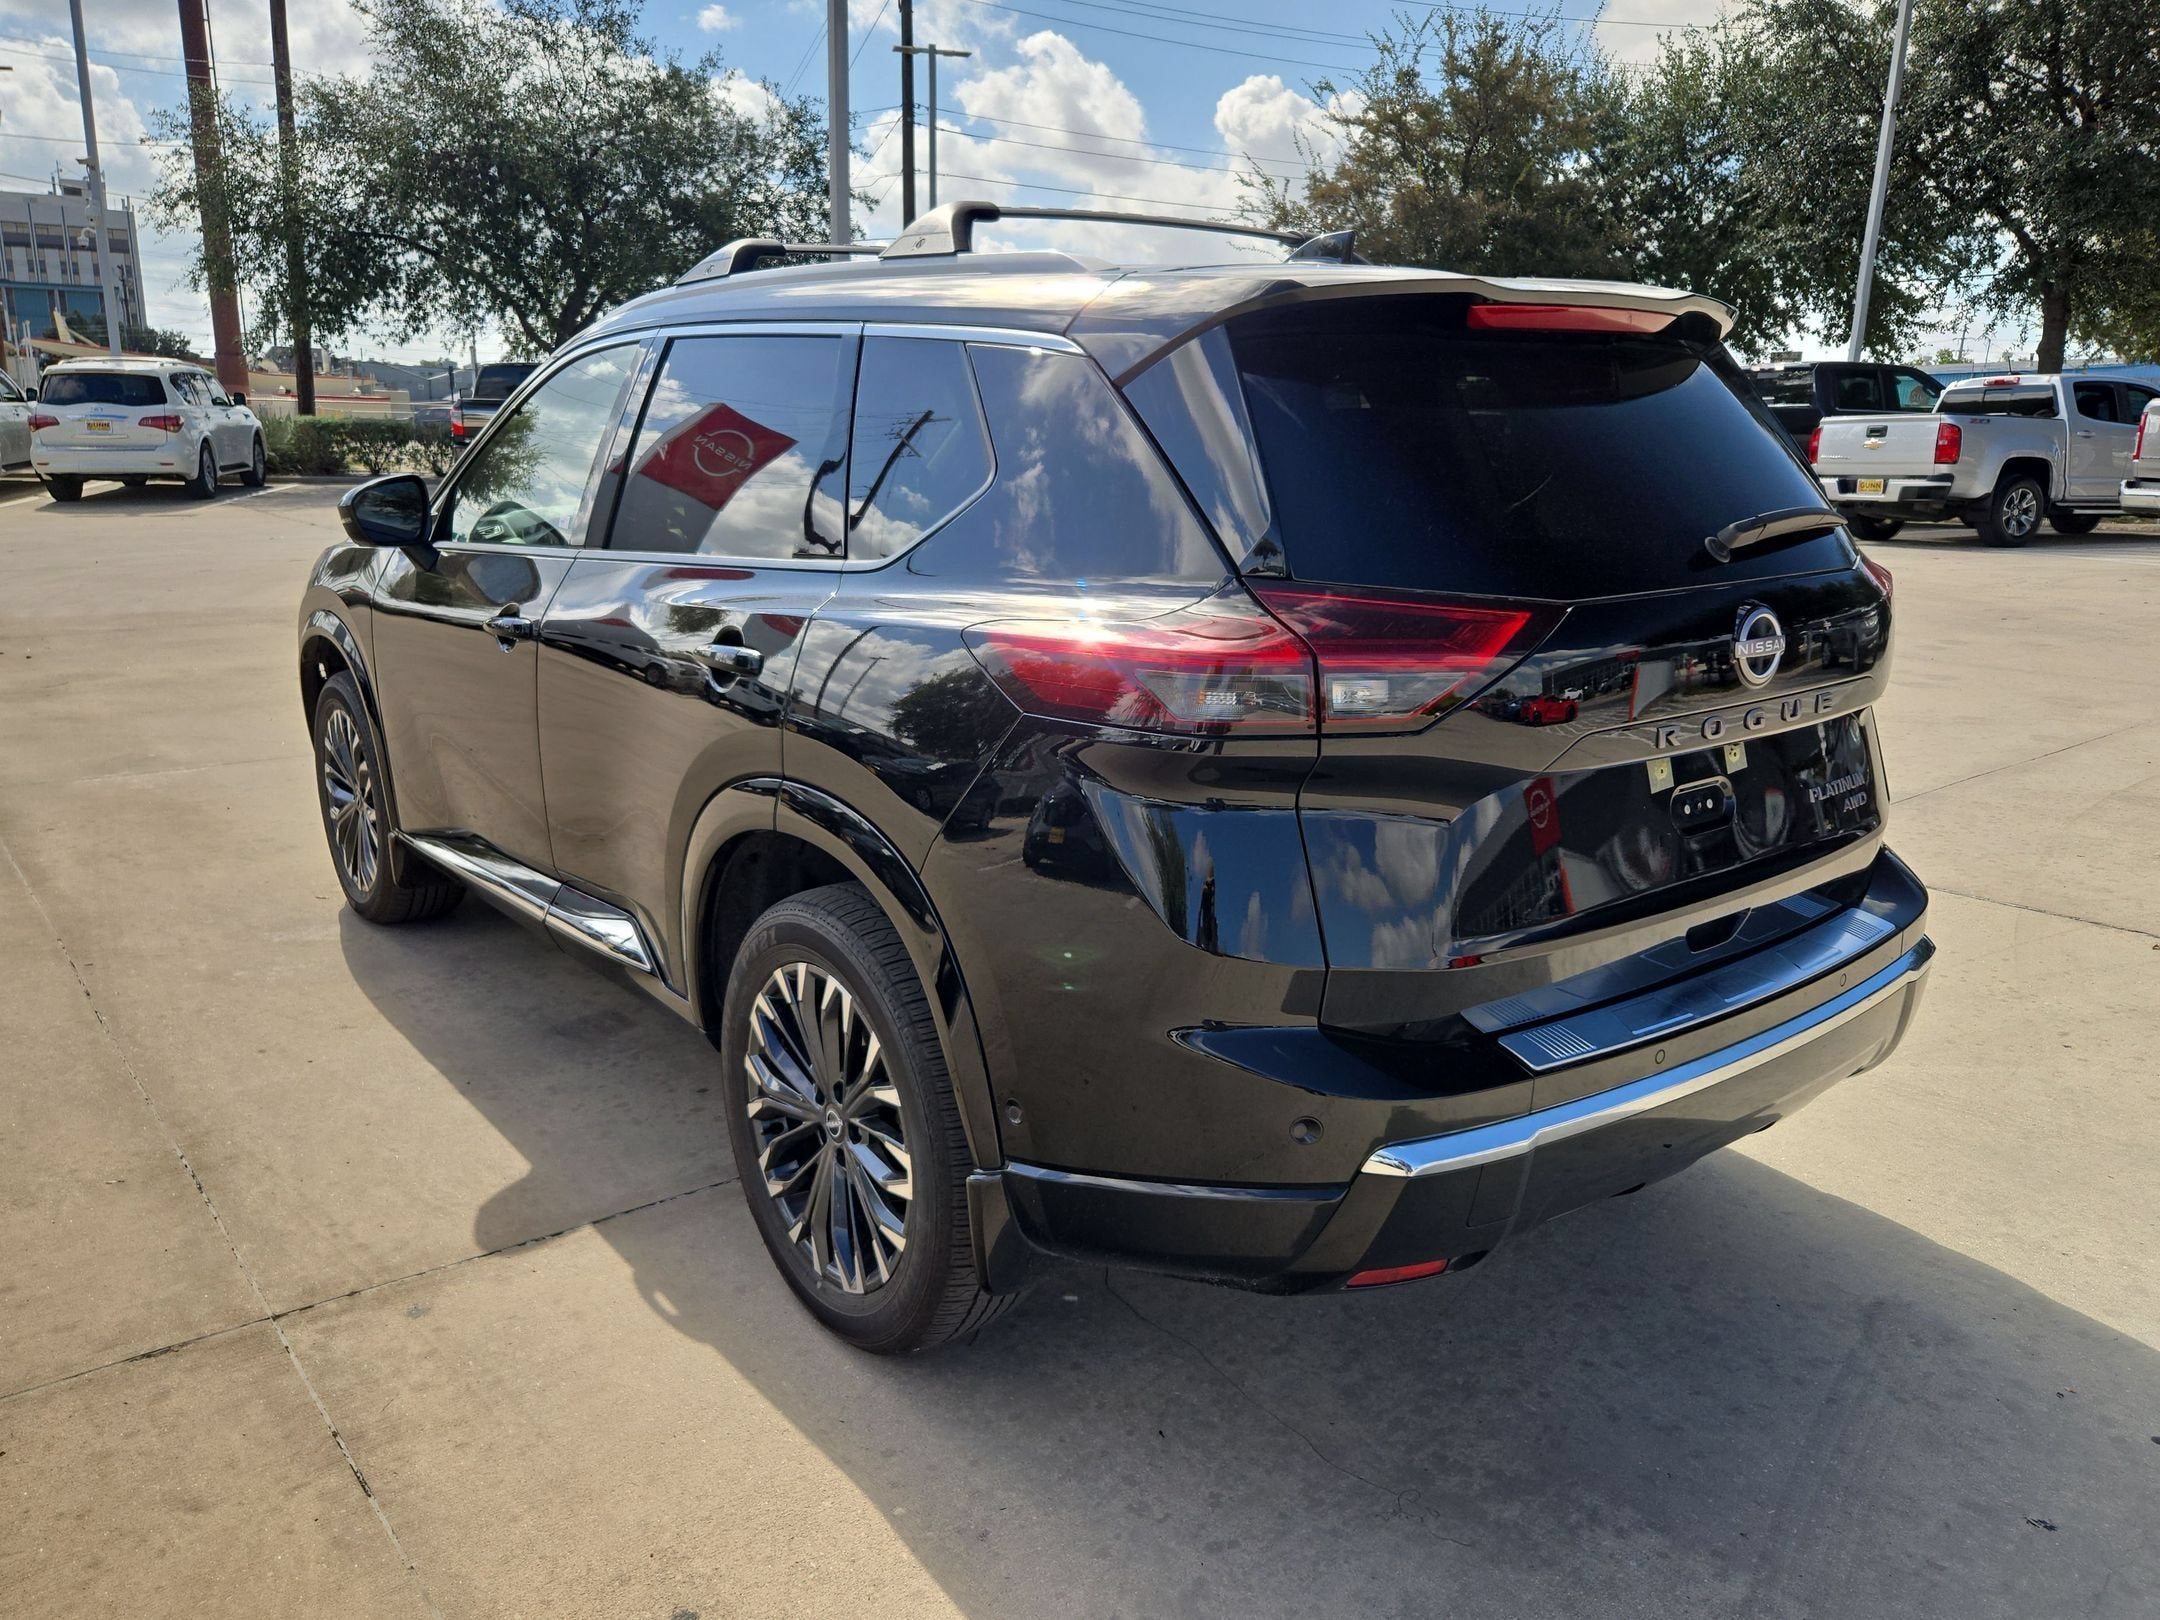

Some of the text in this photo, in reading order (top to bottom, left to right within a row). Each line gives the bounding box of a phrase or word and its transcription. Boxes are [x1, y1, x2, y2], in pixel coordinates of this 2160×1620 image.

[1860, 481, 1881, 489] GUNN
[1737, 638, 1785, 656] NISSAN
[1656, 691, 1833, 749] ROGUE
[1808, 772, 1866, 804] PLATINUM
[1843, 791, 1868, 813] AWD
